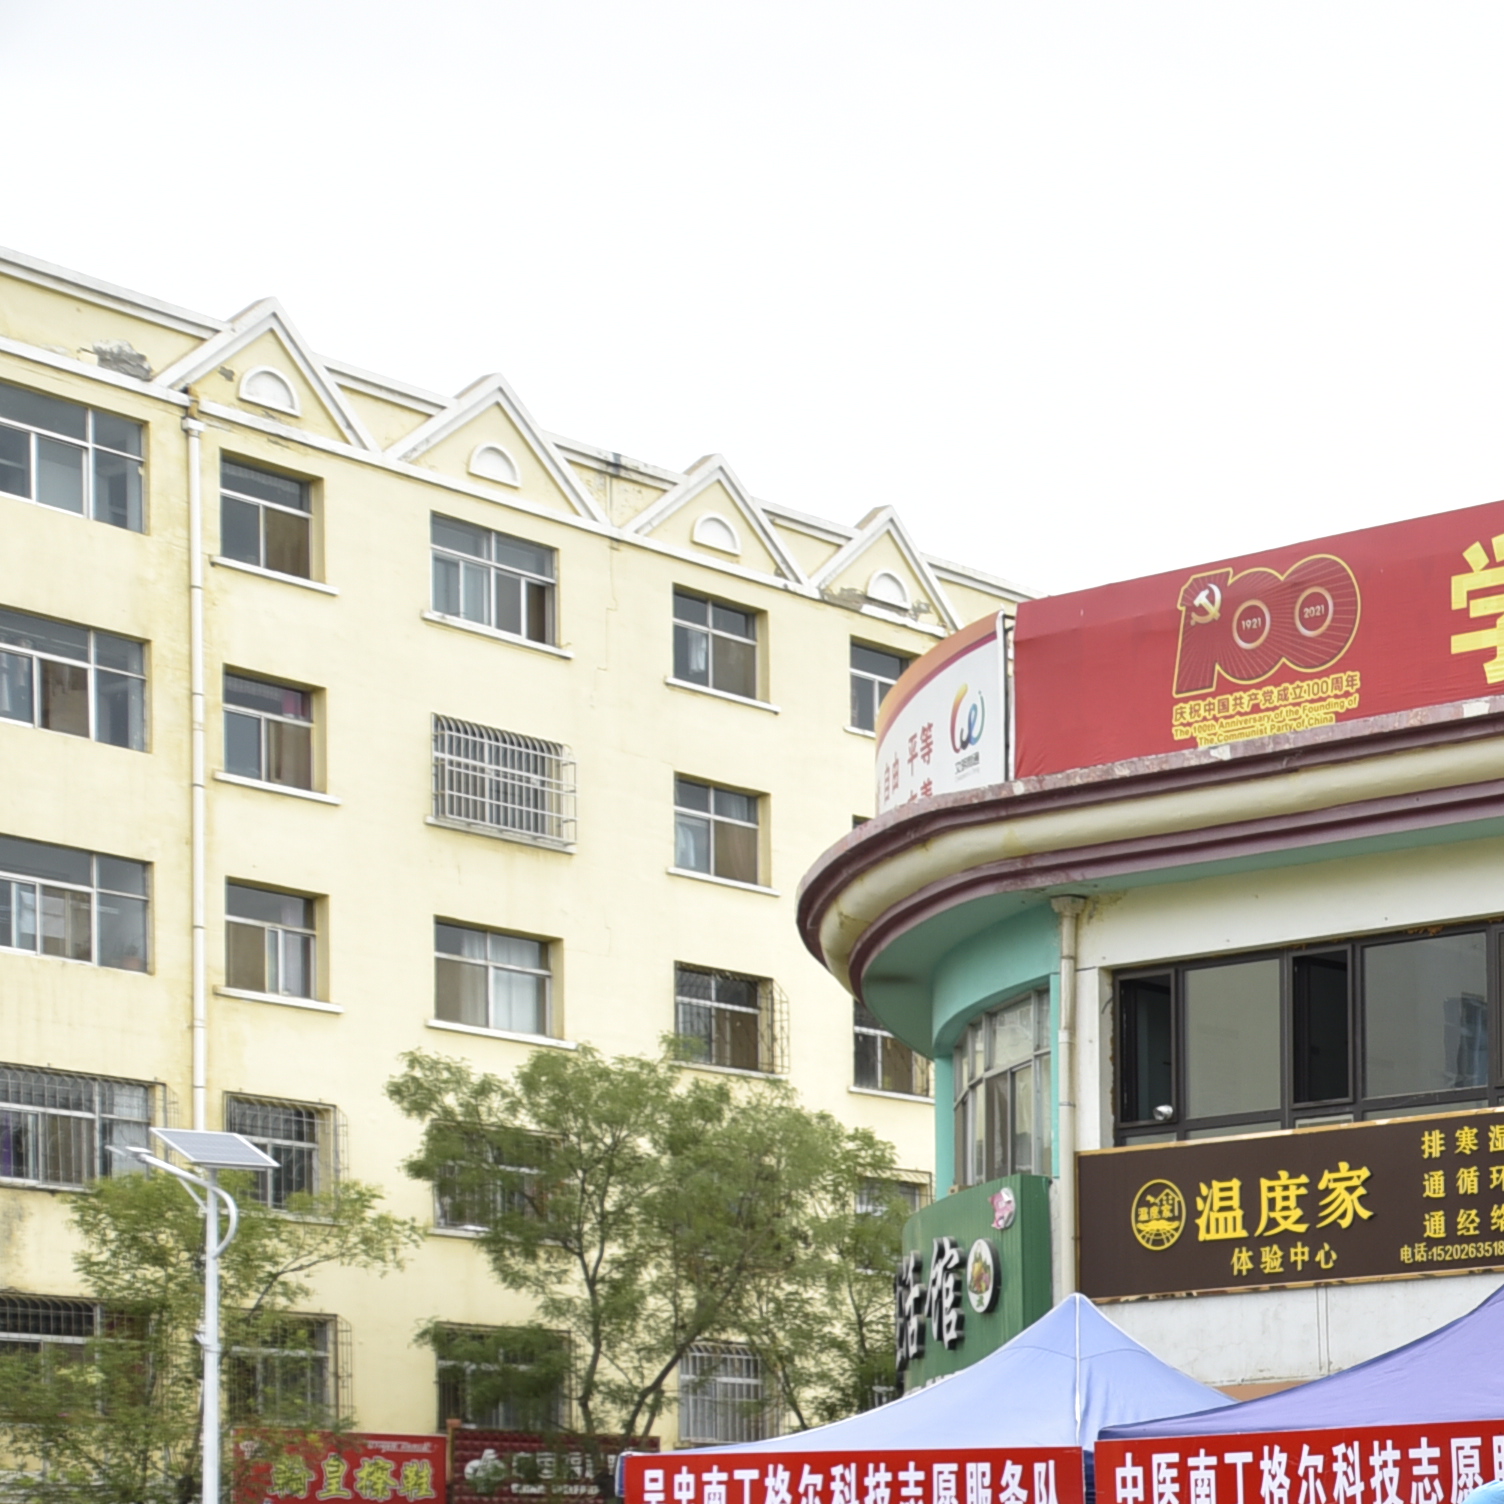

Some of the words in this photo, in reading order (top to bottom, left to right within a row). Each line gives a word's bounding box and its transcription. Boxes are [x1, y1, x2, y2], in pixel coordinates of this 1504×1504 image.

[1241, 618, 1262, 630] 1921
[1303, 604, 1325, 618] 2021
[1173, 673, 1360, 722] 庆祝中国共产党成立100周年
[1174, 728, 1190, 739] The
[1218, 712, 1272, 731] Anniversary
[1302, 698, 1345, 717] Founding
[1199, 735, 1216, 747] The
[1216, 727, 1269, 744] Communist
[1269, 722, 1296, 737] Party
[1307, 715, 1335, 728] China
[907, 721, 934, 777] 平等
[1194, 1161, 1374, 1242] 温度家
[1231, 1241, 1338, 1277] 体验中心
